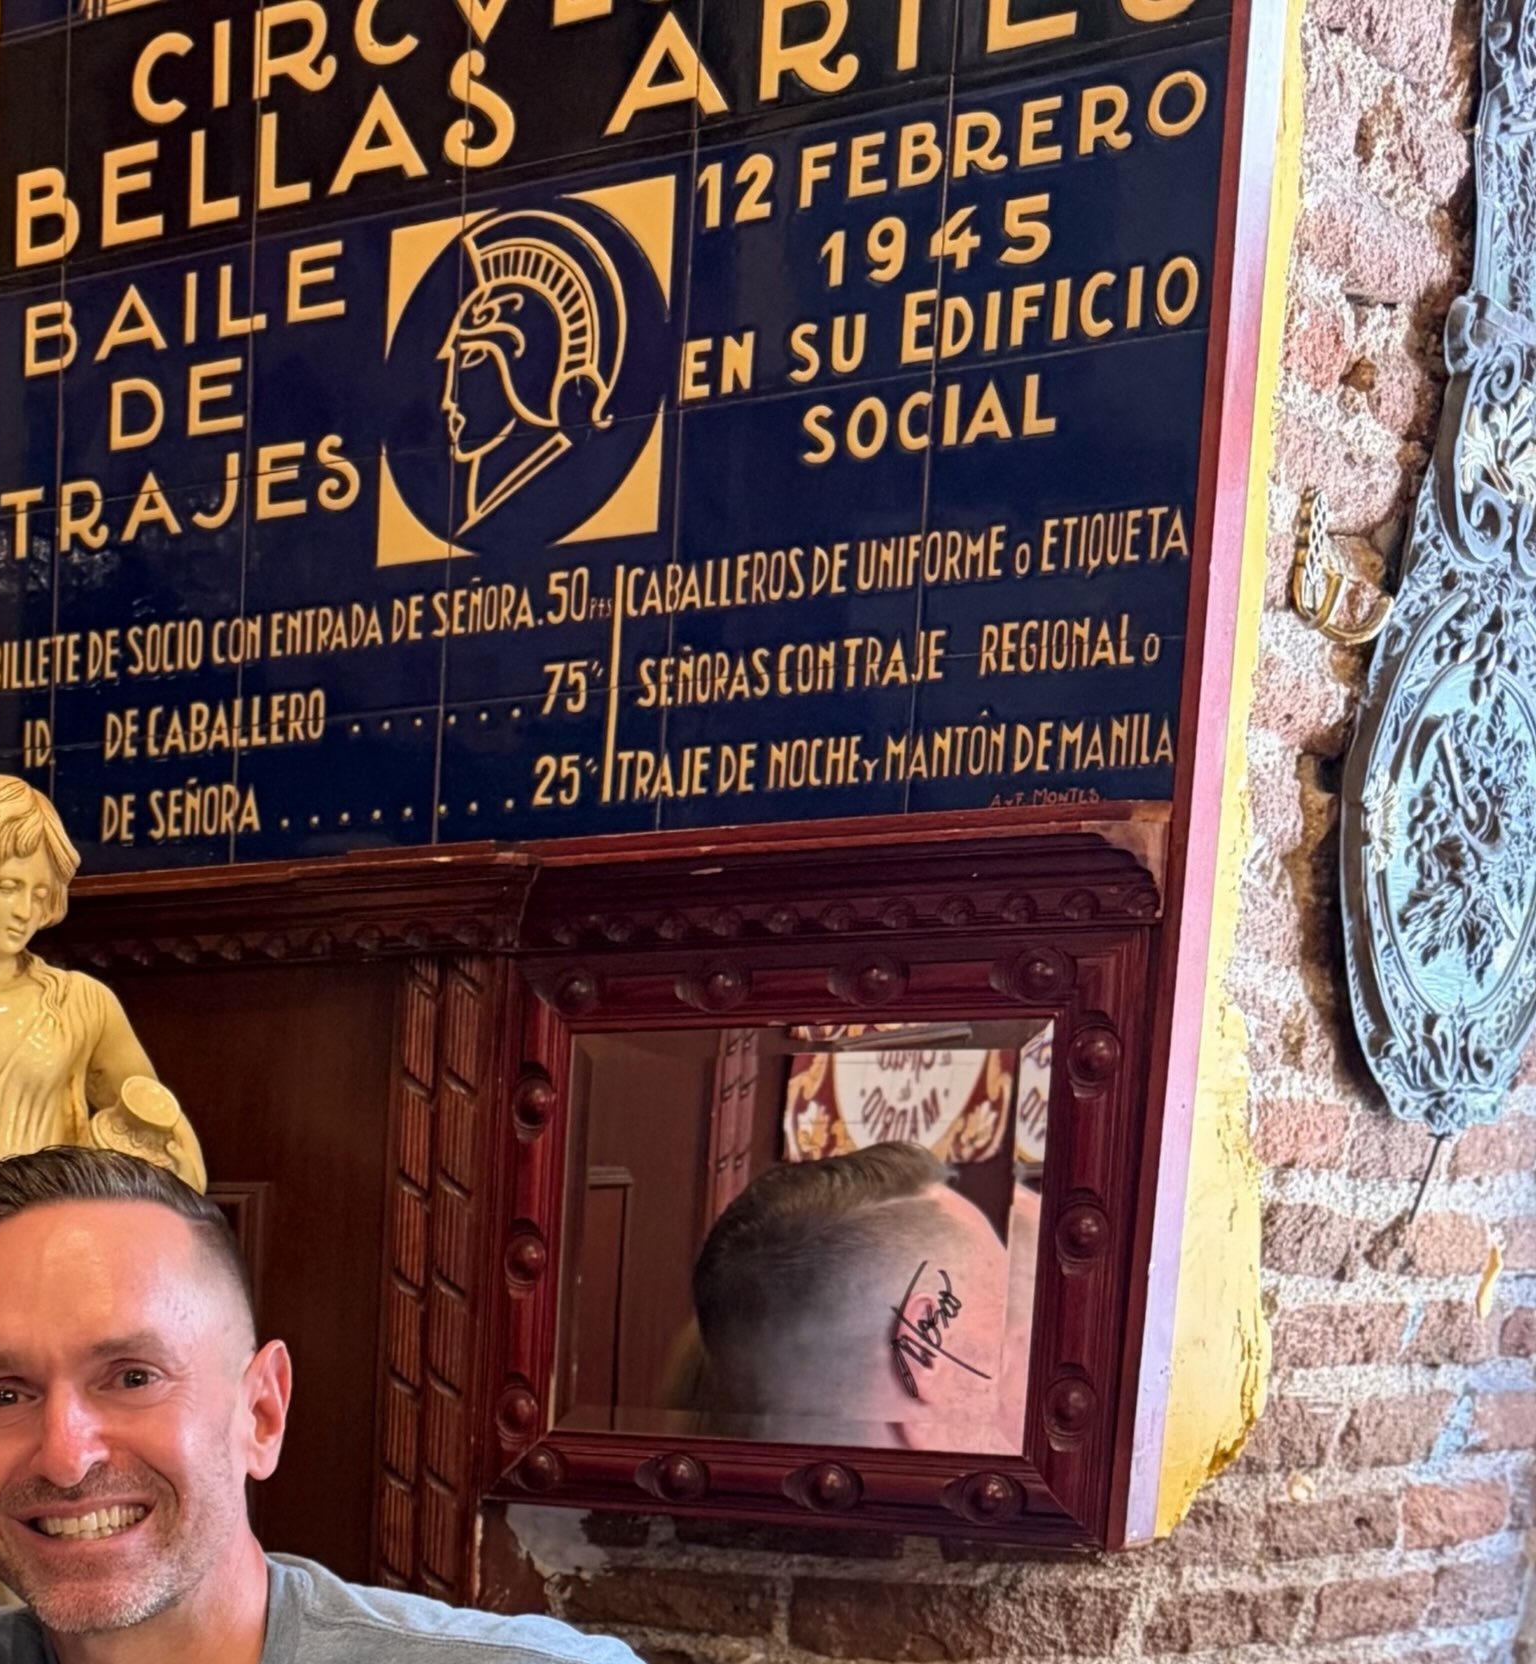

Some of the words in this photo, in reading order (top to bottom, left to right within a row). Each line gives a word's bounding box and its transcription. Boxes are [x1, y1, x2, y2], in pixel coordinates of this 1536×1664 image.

[16, 49, 515, 268] BELLAS
[697, 153, 773, 228] 12
[799, 71, 1205, 208] FEBRERO
[821, 193, 1050, 286] 1945
[25, 240, 345, 377] BAILE
[679, 331, 754, 401] EN
[790, 313, 865, 382] SU
[900, 256, 1198, 364] EDIFICIO
[110, 357, 243, 450] DE
[802, 374, 1055, 464] SOCIAL
[0, 435, 359, 559] TRAJES
[626, 548, 804, 617] CABALLEROS
[812, 543, 847, 594] DE
[857, 526, 1005, 591] UNIFORME
[1040, 507, 1188, 578] ETIQUETA
[87, 630, 117, 679] DE
[127, 619, 202, 674] SOCIO
[212, 613, 261, 664] CON
[270, 604, 381, 657] ENTRADA
[391, 595, 422, 643] DE
[637, 643, 770, 707] SEÑORAS
[777, 644, 834, 695] CON
[844, 630, 946, 688] TRAJE
[979, 615, 1135, 674] REGIONAL
[105, 708, 139, 759] DE
[147, 689, 324, 756] CABALLERO
[617, 746, 711, 800] TRAJE
[718, 742, 758, 793] DE
[768, 736, 862, 787] NOCHE
[884, 709, 1006, 781] MANTÓN
[1013, 722, 1053, 772] DE
[1061, 714, 1173, 766] MANILA
[101, 794, 135, 842] DE
[149, 779, 260, 839] SEÑORA
